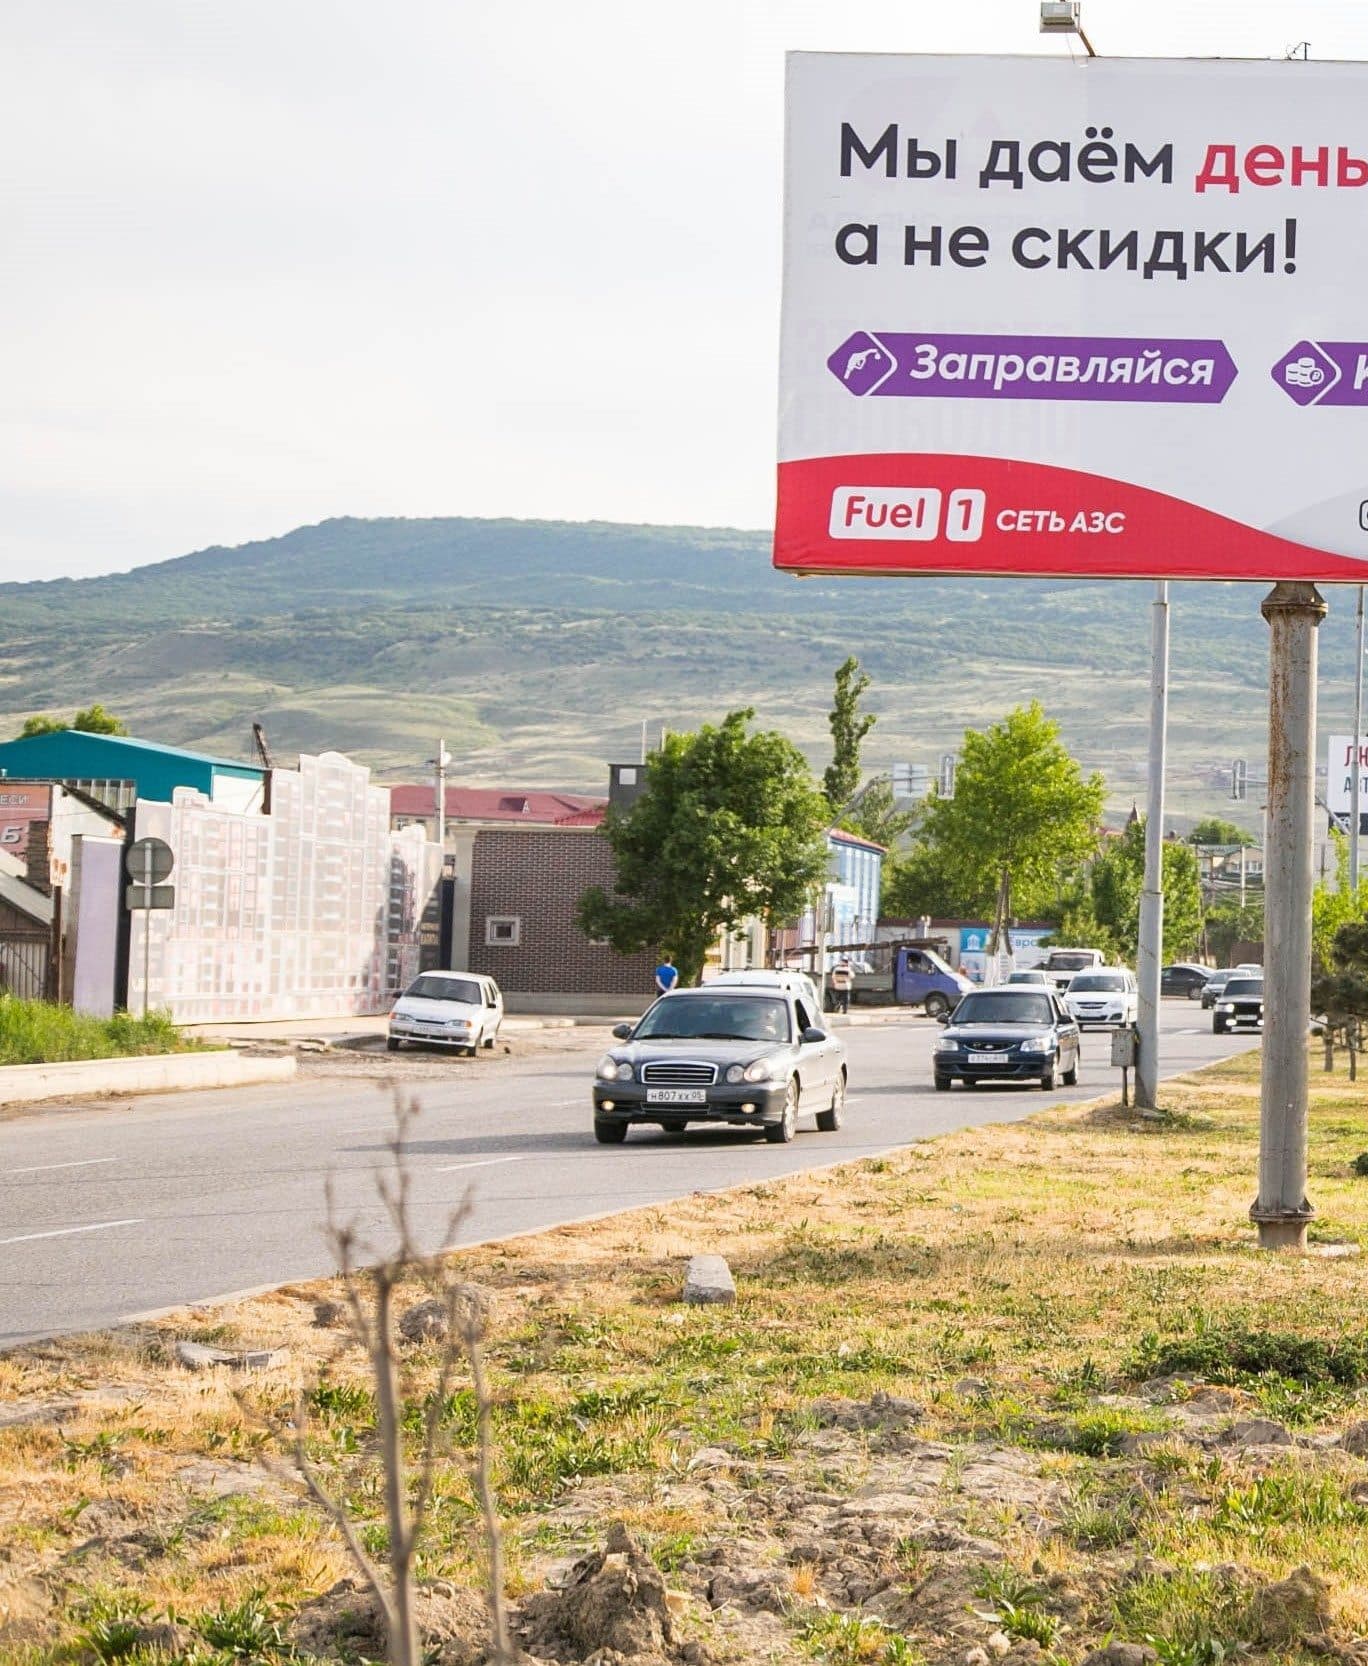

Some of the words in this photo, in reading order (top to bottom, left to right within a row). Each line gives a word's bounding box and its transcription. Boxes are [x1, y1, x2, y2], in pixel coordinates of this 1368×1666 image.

[839, 122, 957, 180] Мы
[978, 126, 1173, 190] даём
[835, 223, 878, 266] а
[904, 225, 990, 268] не
[1011, 218, 1297, 281] скидки!
[909, 344, 1214, 391] Заправляйся
[844, 495, 925, 529] Fuel
[957, 499, 973, 530] 1
[996, 509, 1066, 532] СЕТЬ
[1069, 511, 1126, 534] АЗС
